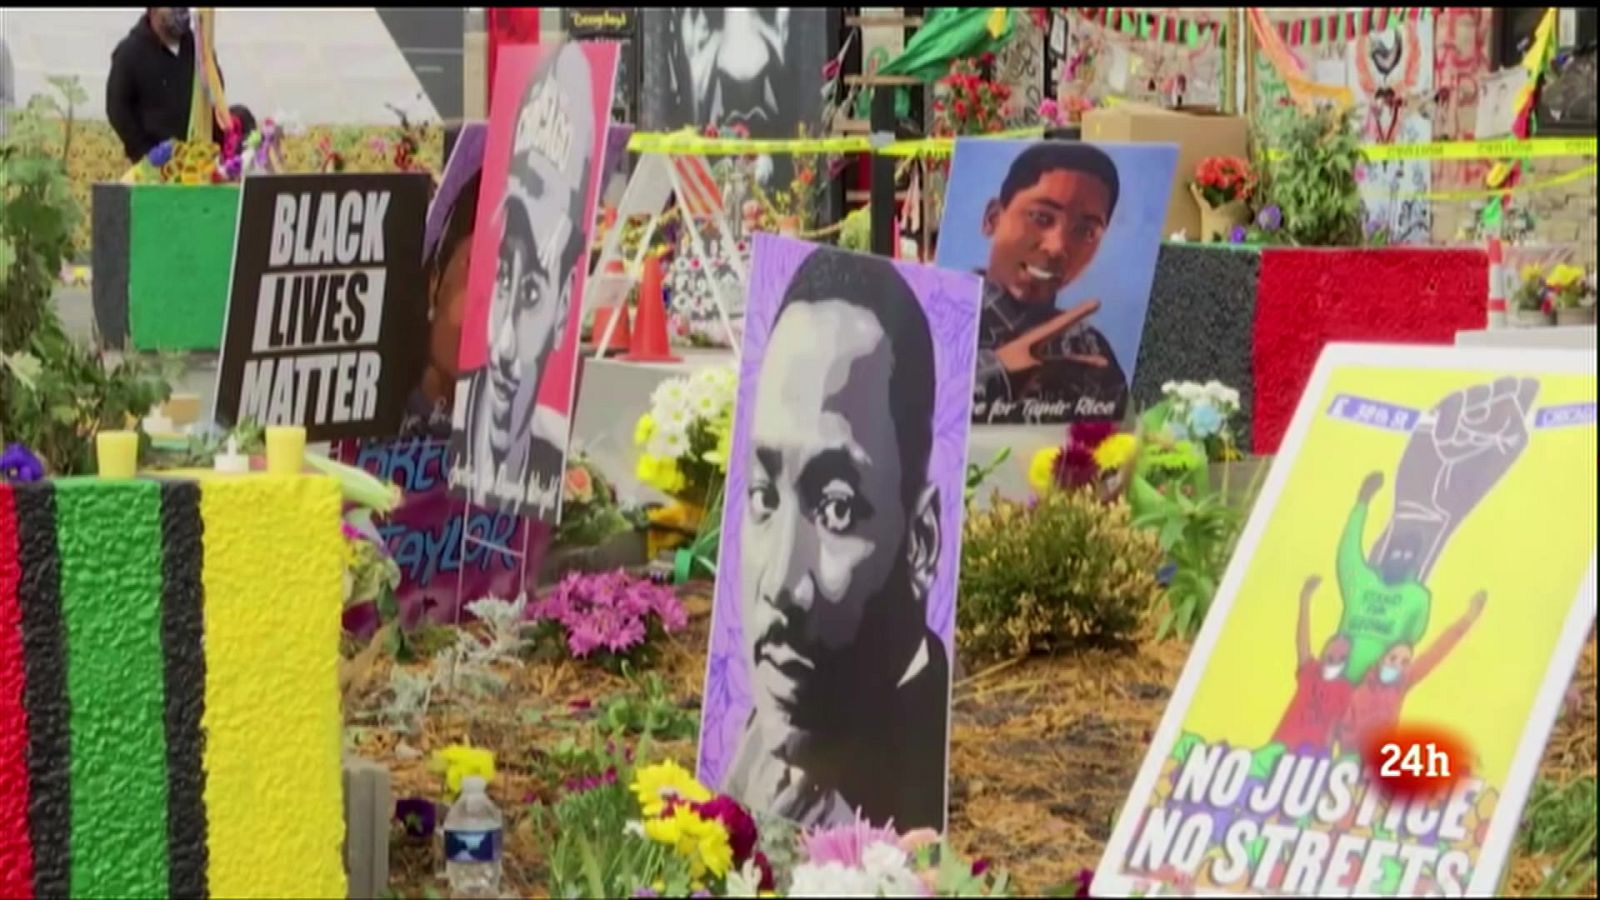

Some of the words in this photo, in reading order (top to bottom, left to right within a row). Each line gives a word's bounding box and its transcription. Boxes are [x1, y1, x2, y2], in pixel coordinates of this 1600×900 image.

[269, 190, 391, 267] BLACK
[267, 271, 369, 348] LIVES
[236, 351, 382, 427] MATTER
[374, 508, 519, 588] TAYLOR
[1172, 742, 1253, 807] NO
[1130, 807, 1214, 874] NO
[1212, 820, 1472, 898] STREETS
